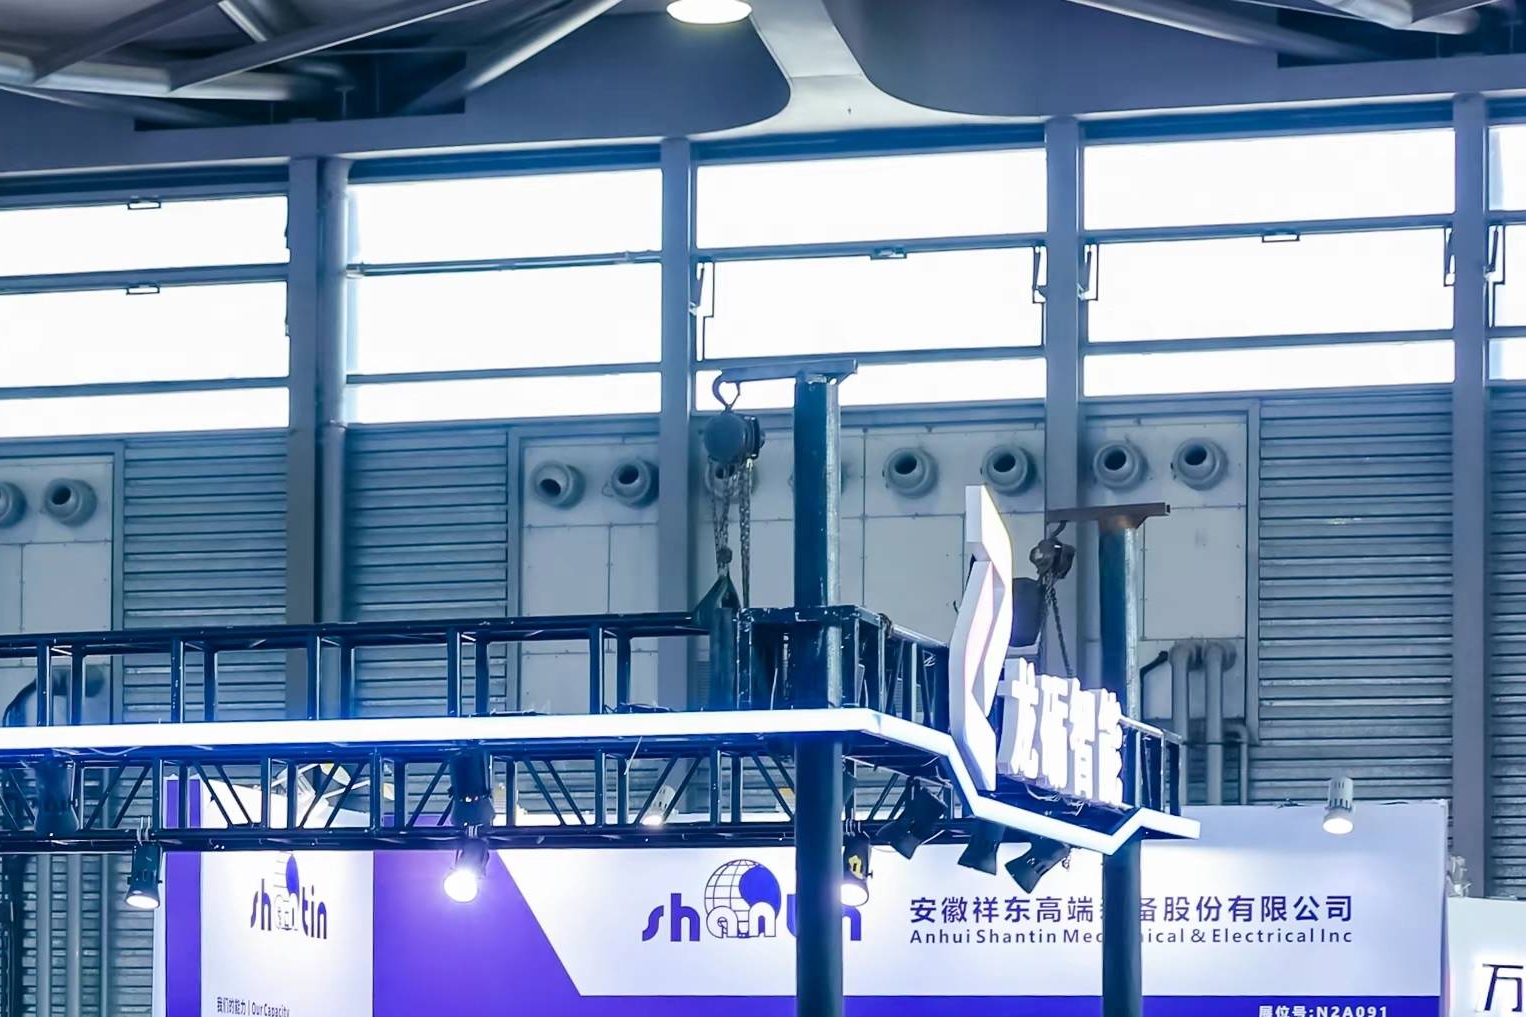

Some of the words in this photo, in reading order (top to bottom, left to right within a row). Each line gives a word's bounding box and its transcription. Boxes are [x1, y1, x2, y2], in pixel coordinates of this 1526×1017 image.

[910, 896, 1352, 923] 安徽祥东高端备股份有限公司
[910, 930, 970, 944] Anhui
[976, 929, 1056, 943] Shantin
[1063, 929, 1185, 943] Mecical
[1190, 929, 1206, 943] &
[1212, 928, 1314, 943] Electrical
[1321, 928, 1352, 943] Inc
